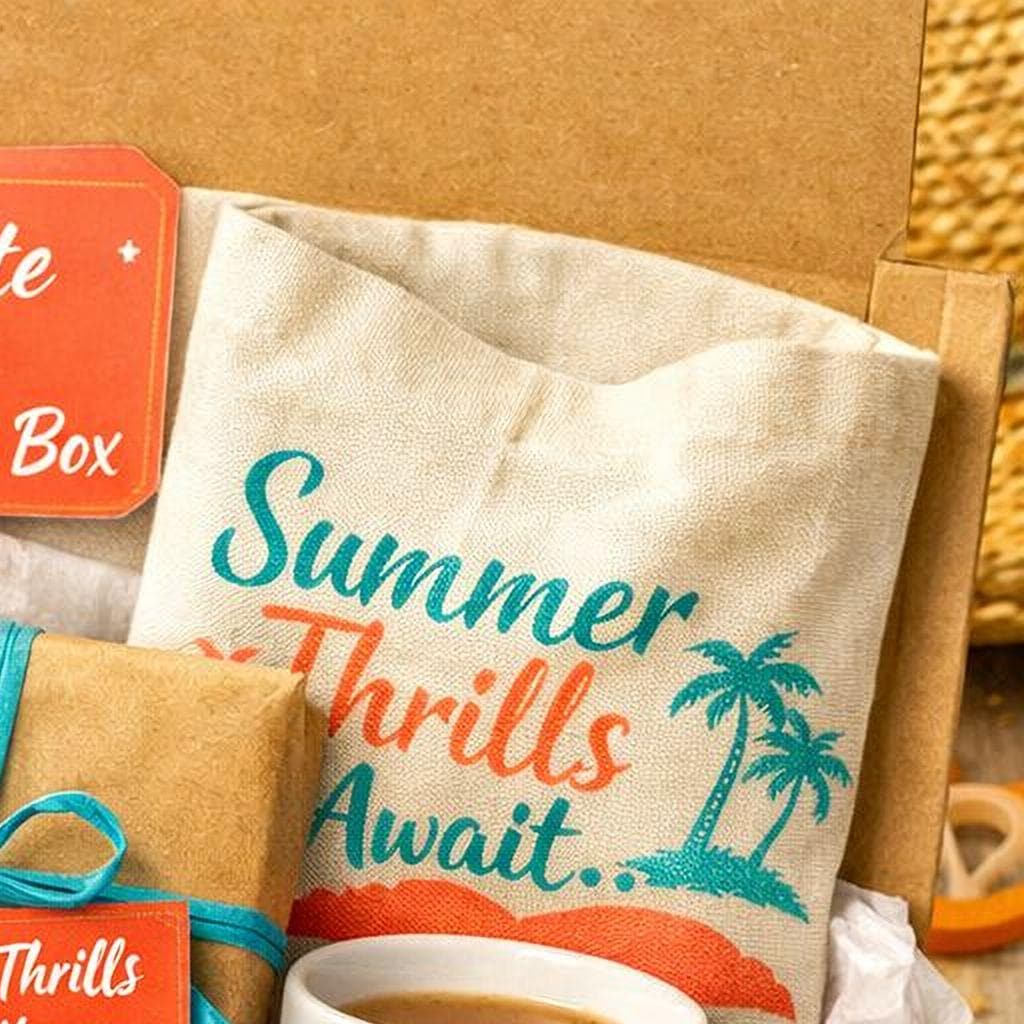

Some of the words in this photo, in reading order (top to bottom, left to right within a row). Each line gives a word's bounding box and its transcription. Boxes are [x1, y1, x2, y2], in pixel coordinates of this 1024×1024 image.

[11, 406, 124, 477] Box
[211, 449, 699, 655] Summer
[262, 604, 631, 792] Thrills
